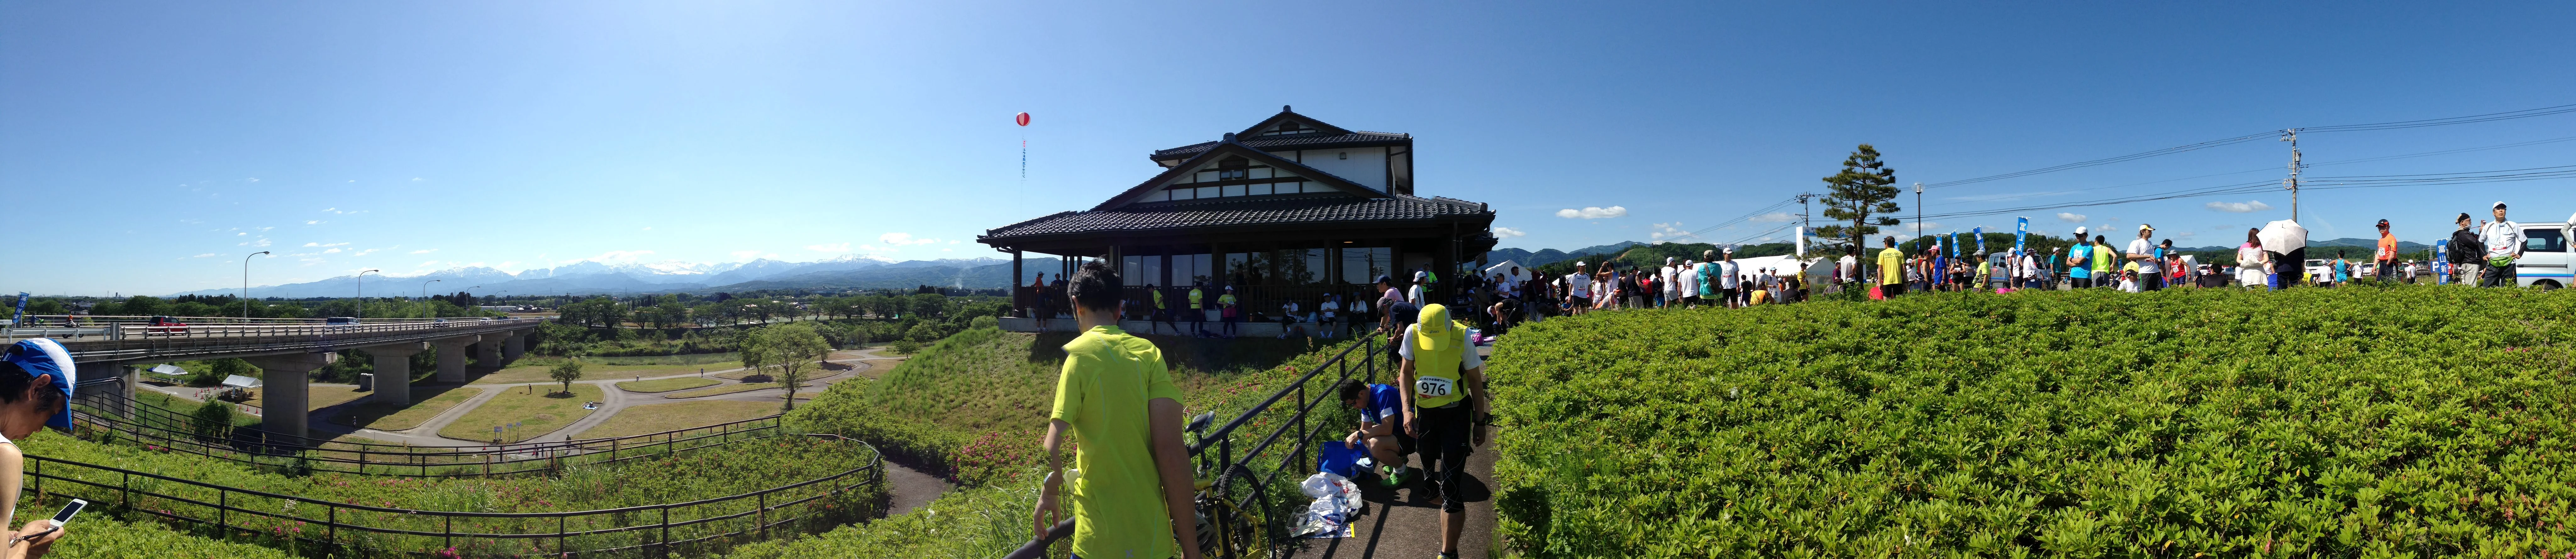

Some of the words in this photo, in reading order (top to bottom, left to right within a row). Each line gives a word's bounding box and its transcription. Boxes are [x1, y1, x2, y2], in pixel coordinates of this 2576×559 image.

[2433, 262, 2439, 271] P
[2438, 245, 2446, 283] 富山新聞
[1422, 382, 1446, 396] 976
